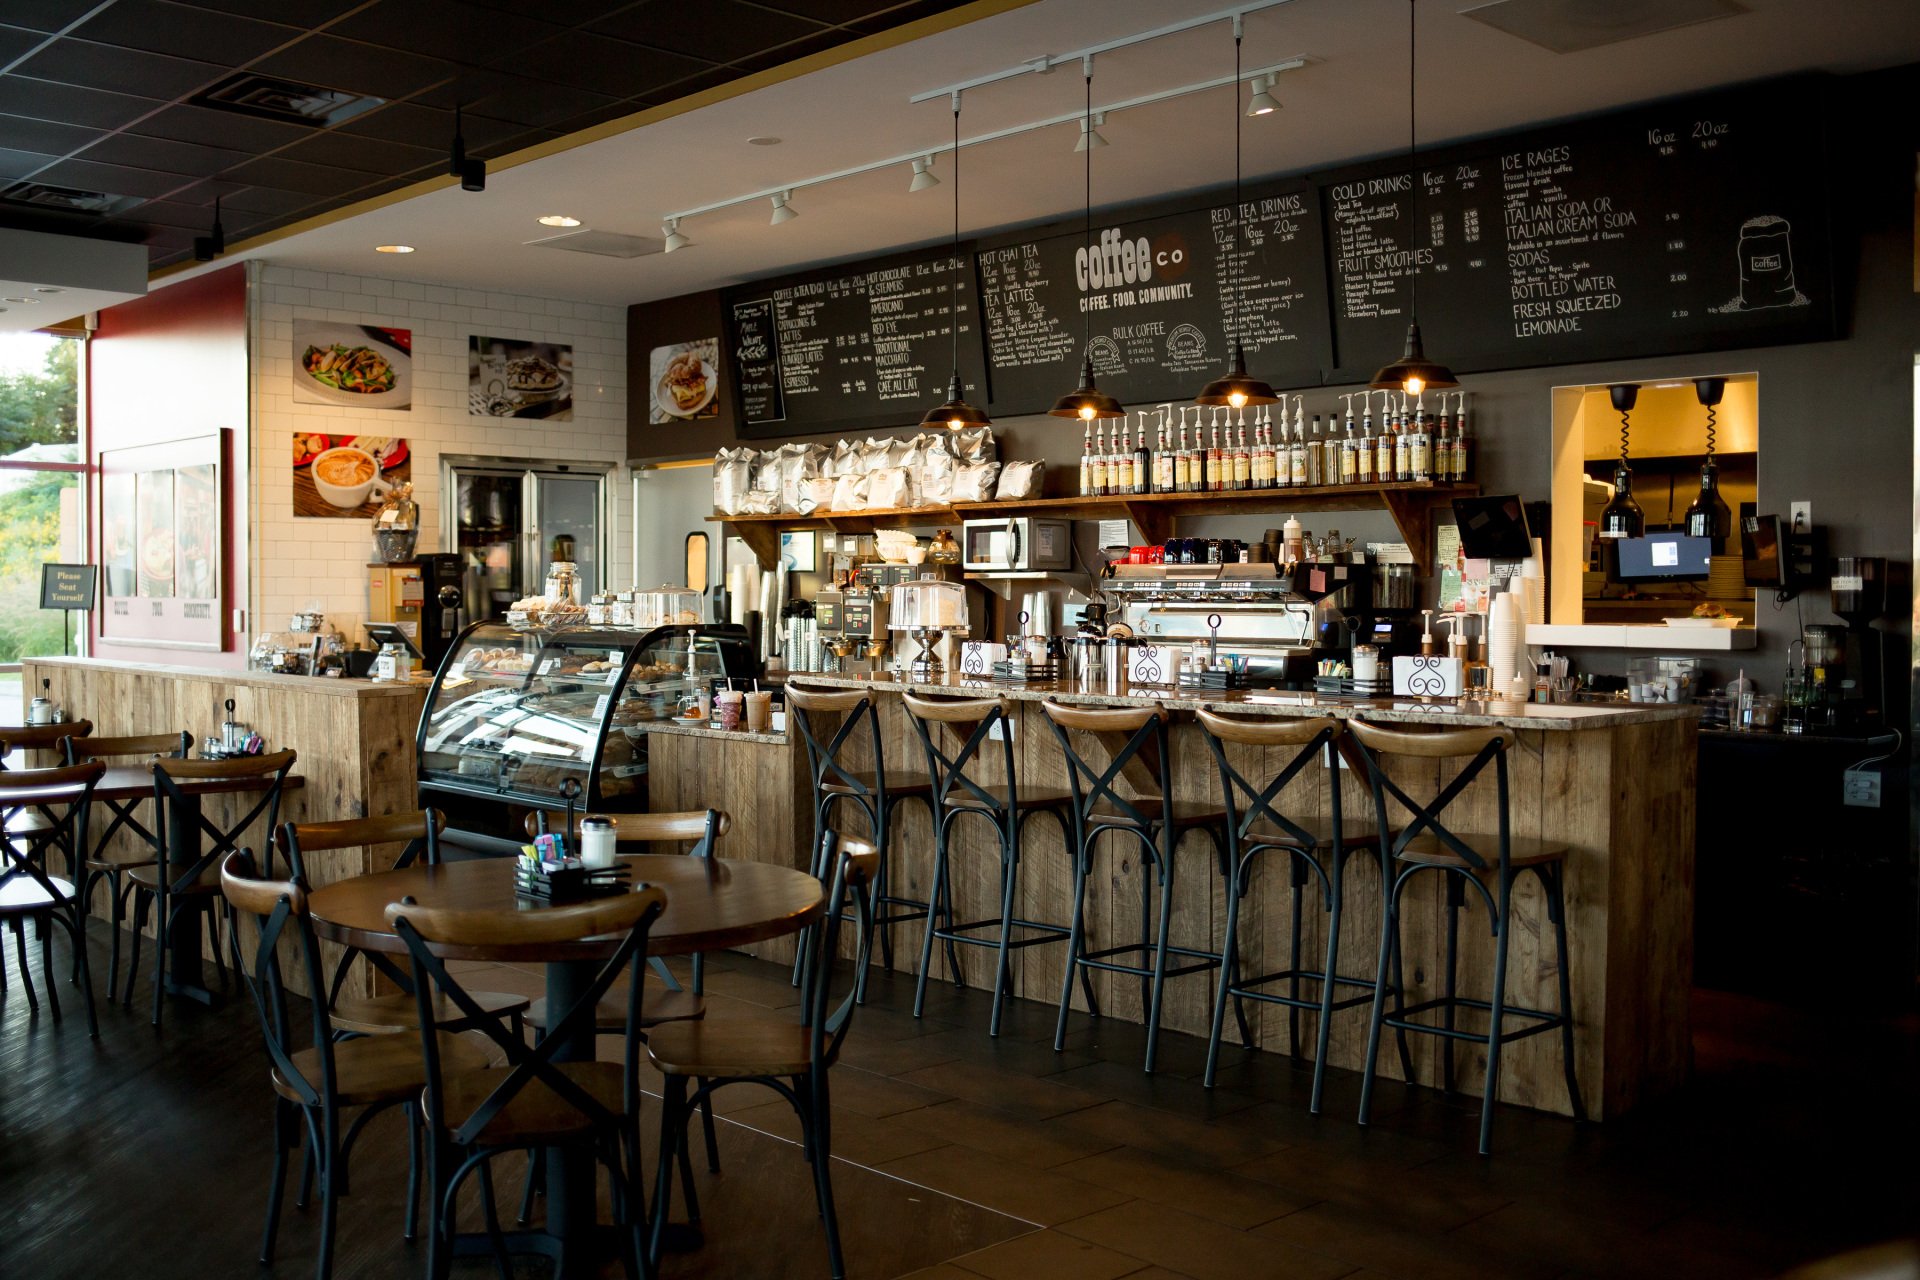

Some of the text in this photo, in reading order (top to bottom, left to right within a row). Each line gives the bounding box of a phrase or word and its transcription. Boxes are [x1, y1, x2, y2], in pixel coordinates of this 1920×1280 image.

[1501, 145, 1571, 172] ICE RAGES
[1503, 164, 1573, 182] Frozen blended coffee
[1332, 182, 1365, 200] COLD
[1369, 174, 1412, 195] DRINKS
[1504, 177, 1551, 191] flavored drink
[1352, 200, 1362, 208] Tea
[1507, 192, 1568, 208] coffee vanilla
[1210, 195, 1300, 223] RED TEA DRINKS
[1504, 196, 1613, 225] ITALIAN SODA OR
[1214, 220, 1300, 244] 12oz 16oz 20oz
[1340, 227, 1353, 235] Iced
[1506, 210, 1637, 240] ITALIAN CREAM SODA
[1341, 235, 1353, 244] Iced
[1342, 243, 1354, 251] Iced
[979, 244, 1039, 267] HOT CHAI TEA
[1075, 227, 1152, 291] coffee
[1338, 248, 1434, 272] FRUIT SMOOTHIES
[1507, 249, 1550, 268] SODAS
[1754, 258, 1778, 269] coffee
[867, 274, 878, 285] HOT
[1670, 274, 1687, 282] 2.00
[1113, 290, 1137, 308] FOOD.
[1139, 283, 1194, 304] COMMUNITY.
[1511, 276, 1617, 300] BOTTLED WATER
[983, 288, 1035, 308] TEA LATTES
[871, 299, 904, 315] AMERICANO
[1347, 303, 1379, 311] Strawberry
[1513, 293, 1622, 320] FRESH SQUEEZED
[873, 321, 898, 335] RED EYE
[1112, 321, 1166, 340] BULK COFFEE
[1515, 317, 1583, 338] LEMONADE
[874, 340, 912, 354] TRADITIONAL
[875, 353, 909, 366] MACCHIATO
[784, 375, 809, 388] ESPRESSO
[903, 377, 917, 390] LAIT
[57, 571, 81, 580] Please
[59, 582, 77, 591] Seat
[52, 593, 84, 601] Yourself
